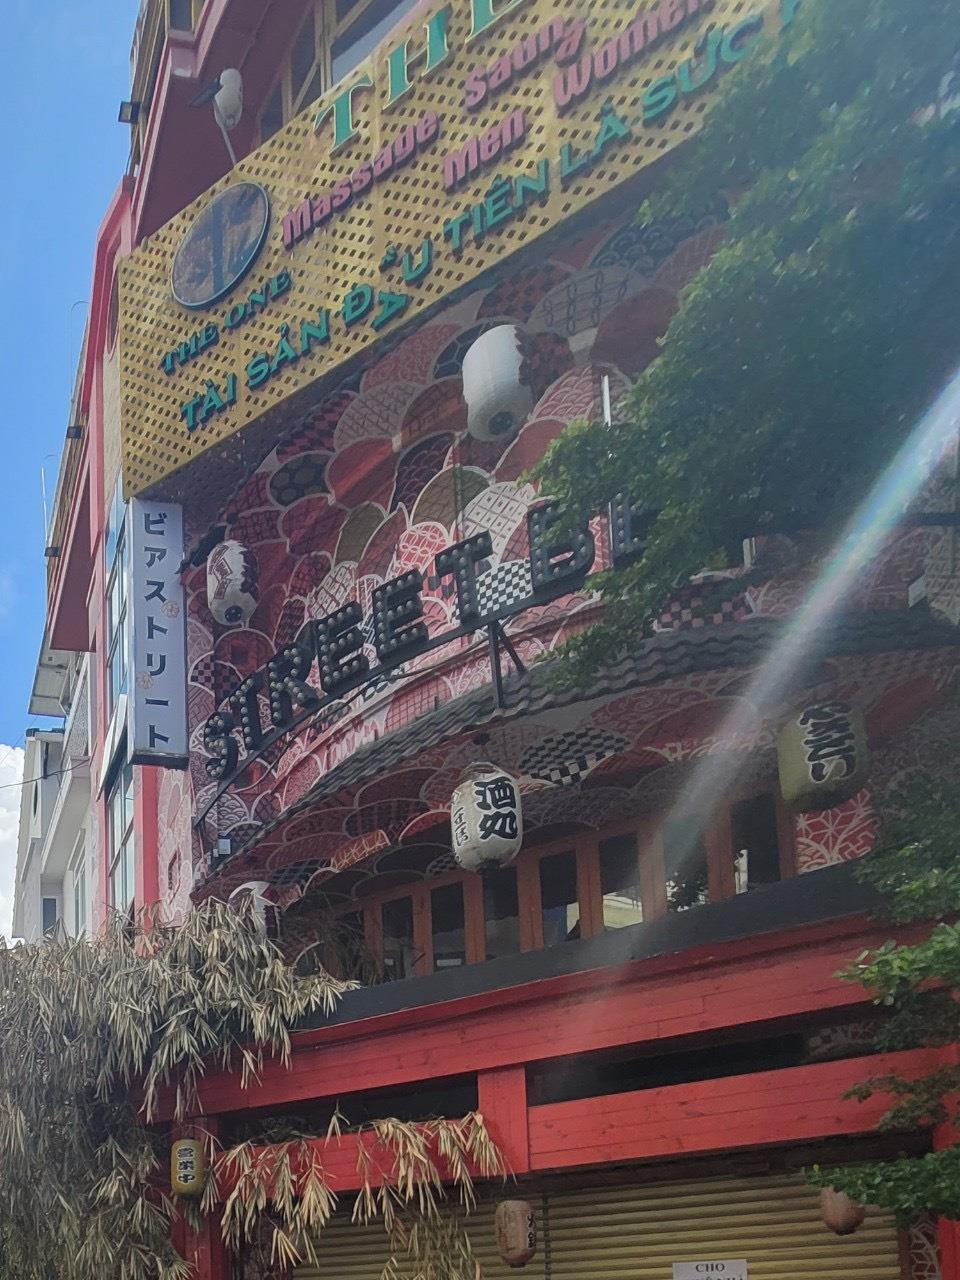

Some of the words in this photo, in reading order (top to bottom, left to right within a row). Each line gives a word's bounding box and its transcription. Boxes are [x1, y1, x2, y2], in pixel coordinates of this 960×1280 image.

[443, 158, 549, 252] TIÊN
[160, 321, 218, 376] THE
[224, 267, 292, 329] ONE
[143, 511, 171, 748] ビアストリート
[203, 530, 494, 781] STREET
[695, 1263, 725, 1273] CHO
